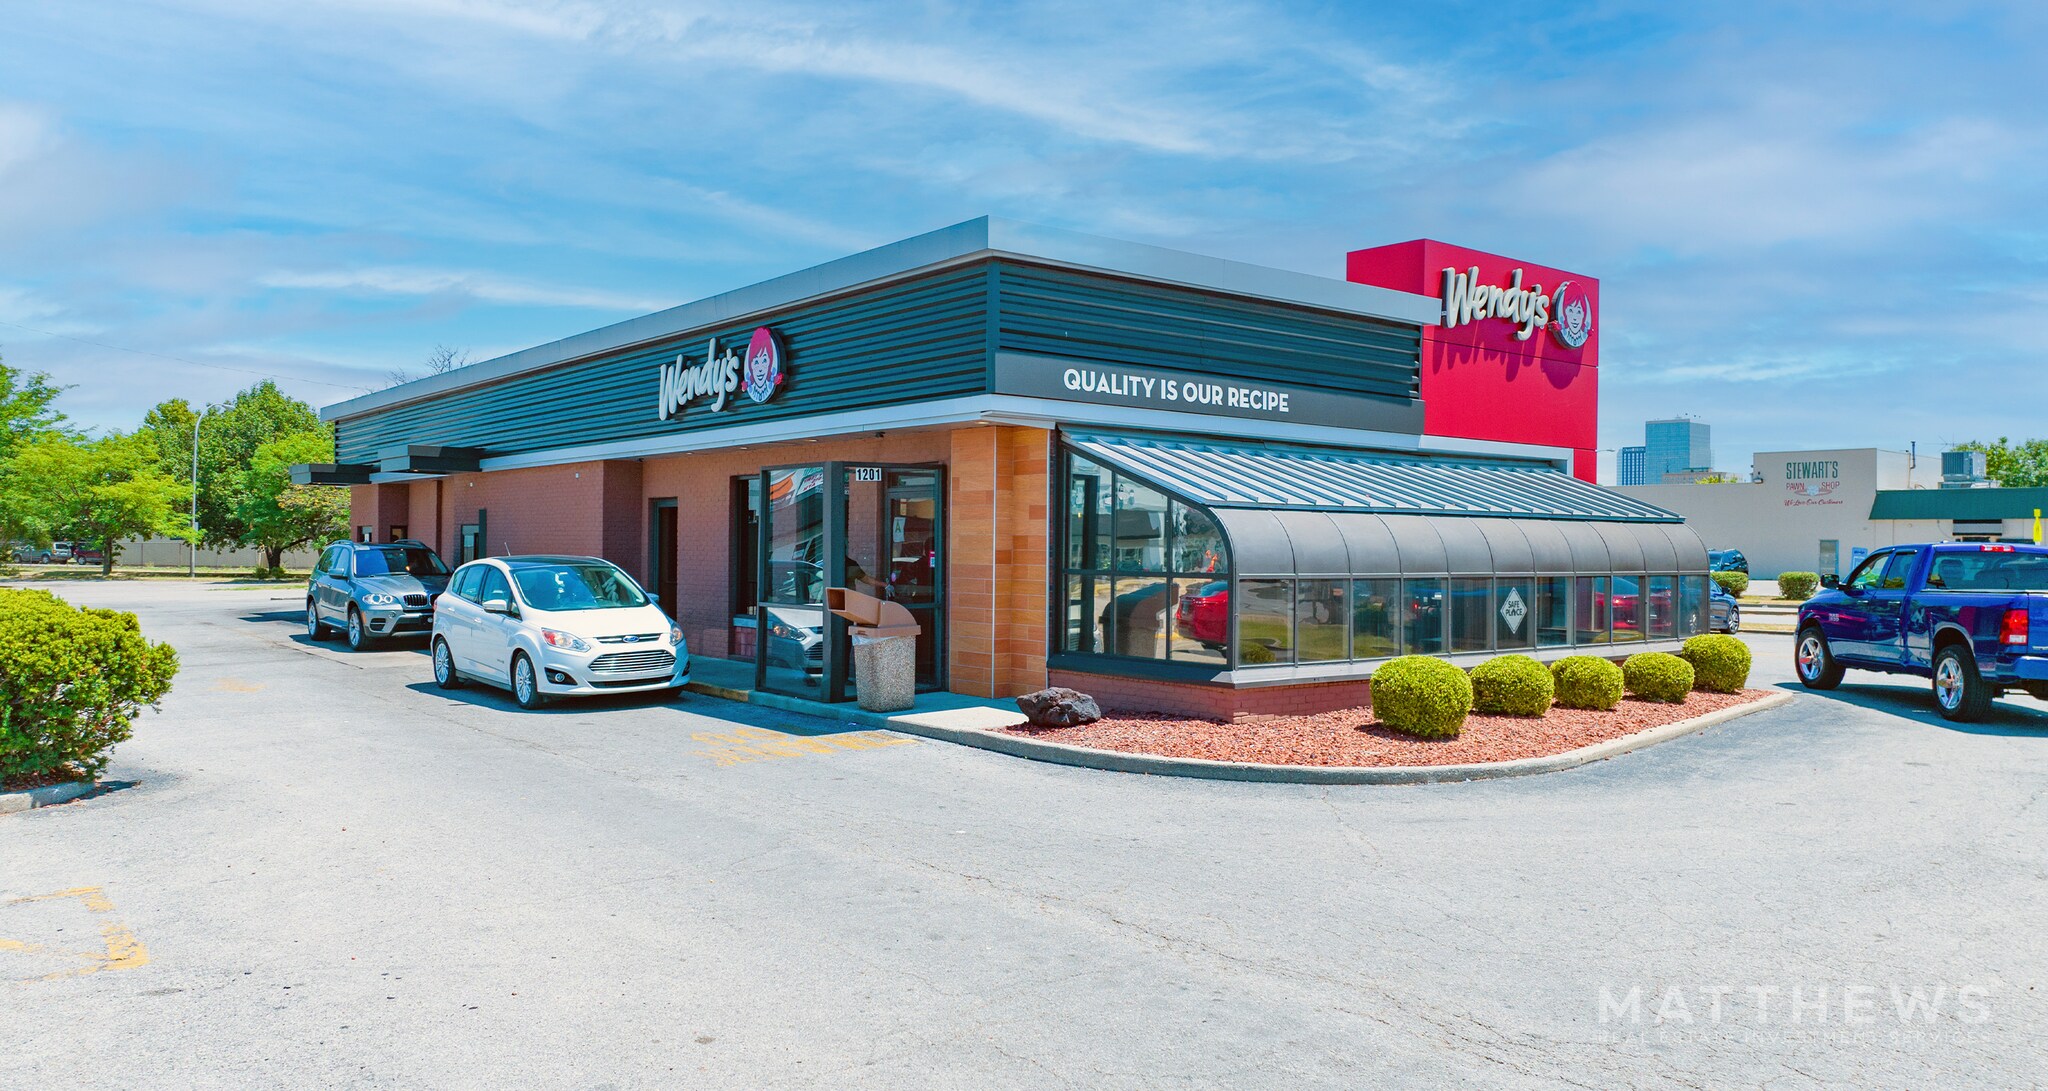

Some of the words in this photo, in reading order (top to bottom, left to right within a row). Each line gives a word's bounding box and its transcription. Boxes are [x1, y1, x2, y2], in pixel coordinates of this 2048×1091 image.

[1442, 266, 1550, 341] Wendy's
[659, 338, 740, 421] Wendy's
[1063, 368, 1156, 398] QUALITY
[1160, 379, 1178, 401] IS
[1182, 382, 1223, 406] OUR
[1228, 387, 1290, 413] RECIPE
[856, 468, 880, 480] 1201
[1786, 460, 1838, 480] STEWART'S
[1822, 481, 1840, 490] SHOP
[1506, 608, 1522, 616] PLACE
